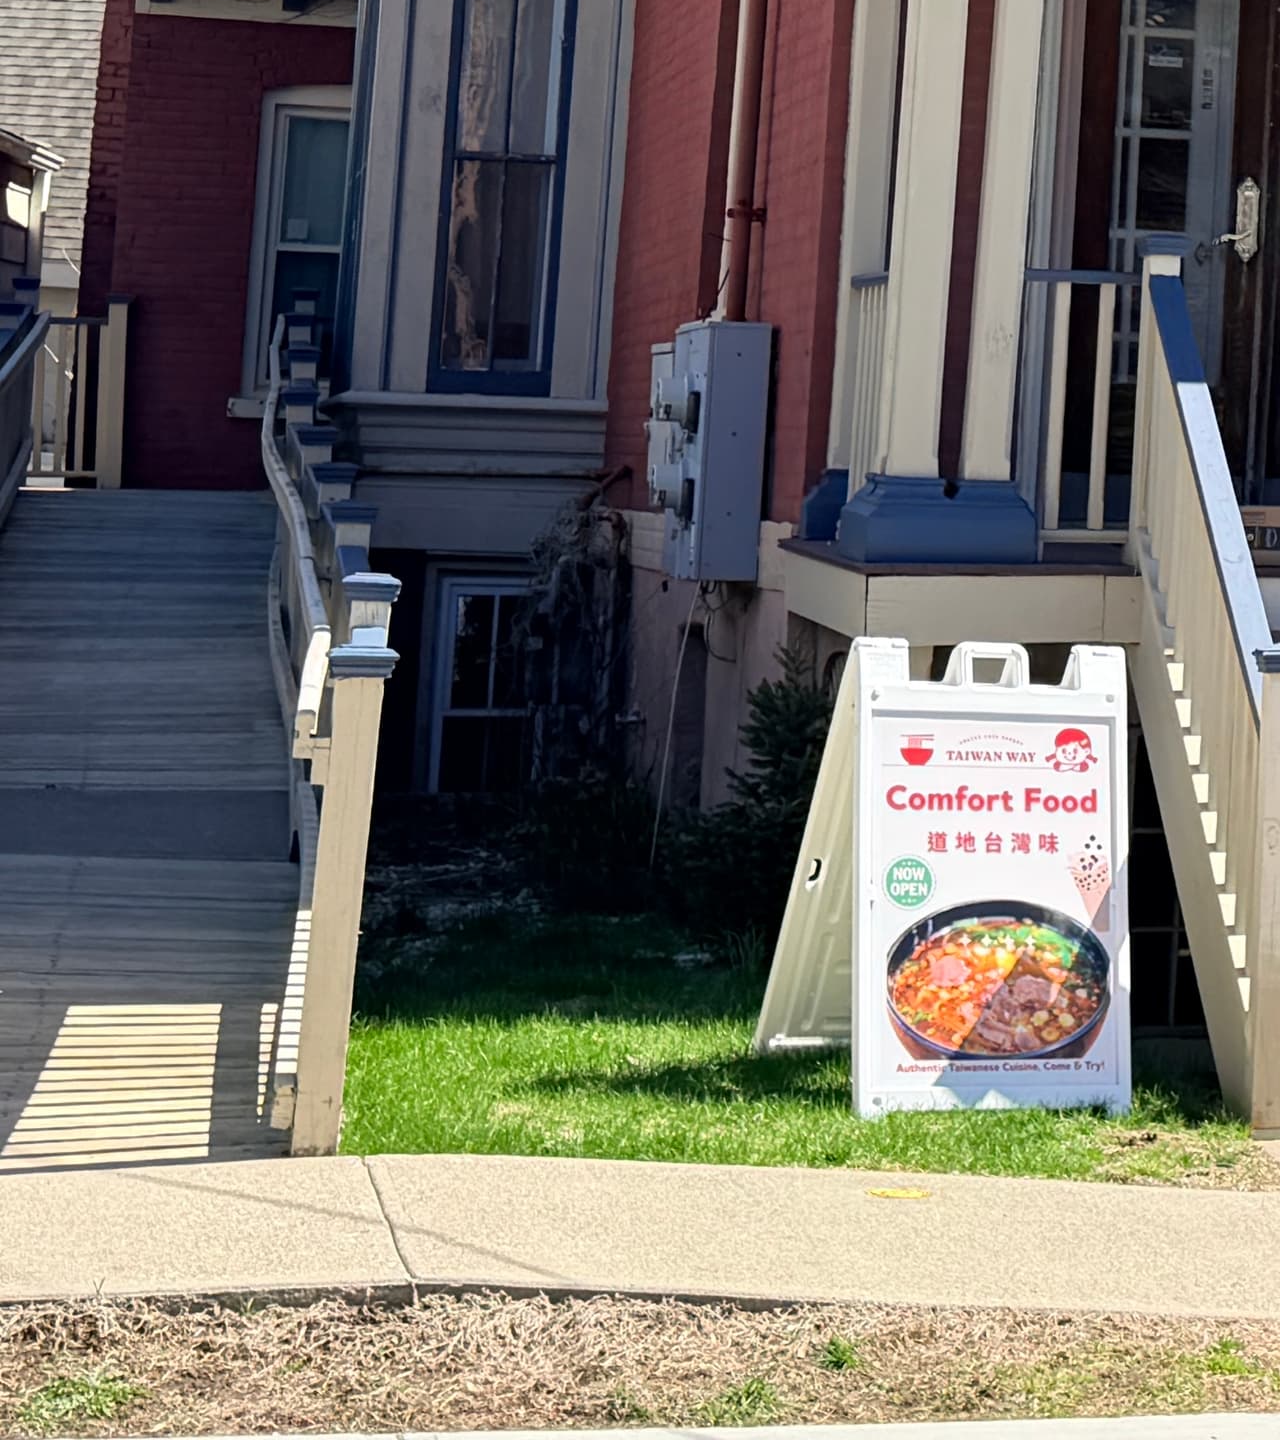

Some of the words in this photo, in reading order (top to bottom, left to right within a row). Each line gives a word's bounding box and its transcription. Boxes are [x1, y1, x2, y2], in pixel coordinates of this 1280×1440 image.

[945, 750, 1003, 762] TAIWAN
[1005, 751, 1037, 763] WAY
[886, 785, 1014, 812] Comfort
[1024, 787, 1098, 814] Food
[927, 831, 1060, 855] 道地台灣味
[893, 866, 926, 882] NOW
[889, 882, 929, 897] OPEN
[896, 1063, 946, 1073] Authentic
[949, 1063, 1000, 1073] Taiwanese
[1043, 1061, 1071, 1071] Come
[1073, 1061, 1083, 1071] &
[1085, 1060, 1105, 1073] Try!
